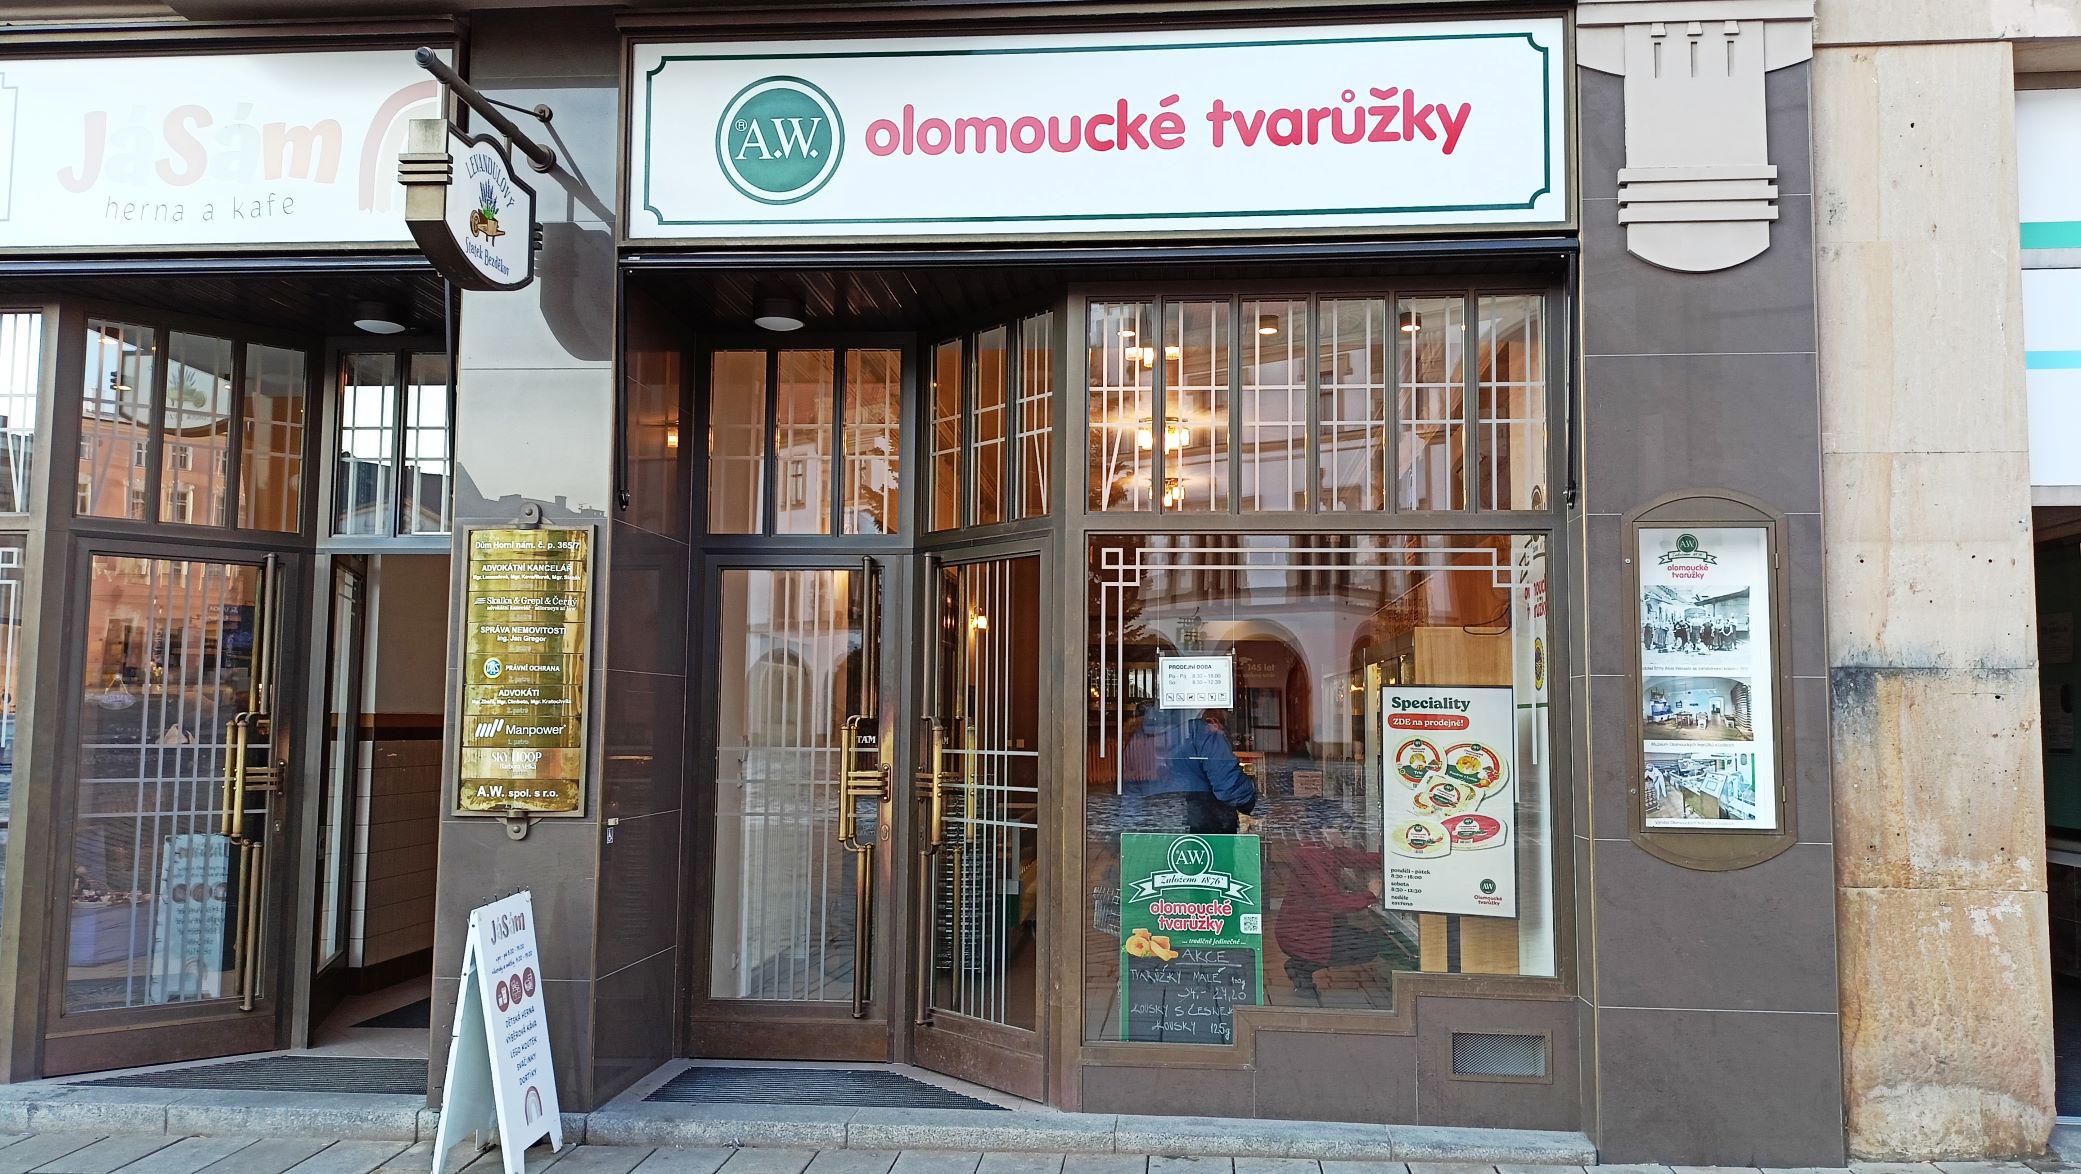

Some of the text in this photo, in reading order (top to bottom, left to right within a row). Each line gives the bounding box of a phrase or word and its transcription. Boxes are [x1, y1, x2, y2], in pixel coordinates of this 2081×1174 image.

[865, 87, 1472, 156] olomoucké tvarůžky
[56, 102, 343, 194] JáSám
[105, 192, 295, 222] herna a kafe
[465, 236, 483, 260] Statek
[475, 541, 492, 549] Dům
[515, 541, 536, 549] nám.
[547, 542, 555, 550] p.
[481, 561, 572, 572] ADVOKÁTNÍ KANCELÁŘ
[1667, 563, 1709, 571] olomoucké
[1672, 571, 1705, 580] tvarůžky
[486, 595, 578, 606] Skalka & Grepl & Černý
[480, 624, 511, 634] SPRÁVA
[497, 635, 509, 643] Ing.
[523, 635, 547, 643] Gregor
[505, 663, 560, 672] PRÁVNÍ OCHRANA
[1247, 663, 1275, 672] 145 let
[498, 688, 540, 697] ADVOKÁTI
[1391, 696, 1471, 712] Speciality
[1392, 718, 1411, 726] ZDE
[505, 724, 564, 737] Manpower
[857, 735, 877, 744] TAM
[491, 751, 508, 762] SKY
[477, 785, 559, 799] A.W. spol. s r.o.
[1175, 850, 1206, 865] A.W.
[1160, 875, 1197, 884] Založeno
[1150, 899, 1232, 916] olomoucké
[490, 911, 526, 946] JáSám
[1159, 915, 1224, 934] tvarůžky
[1182, 948, 1230, 963] AKCE
